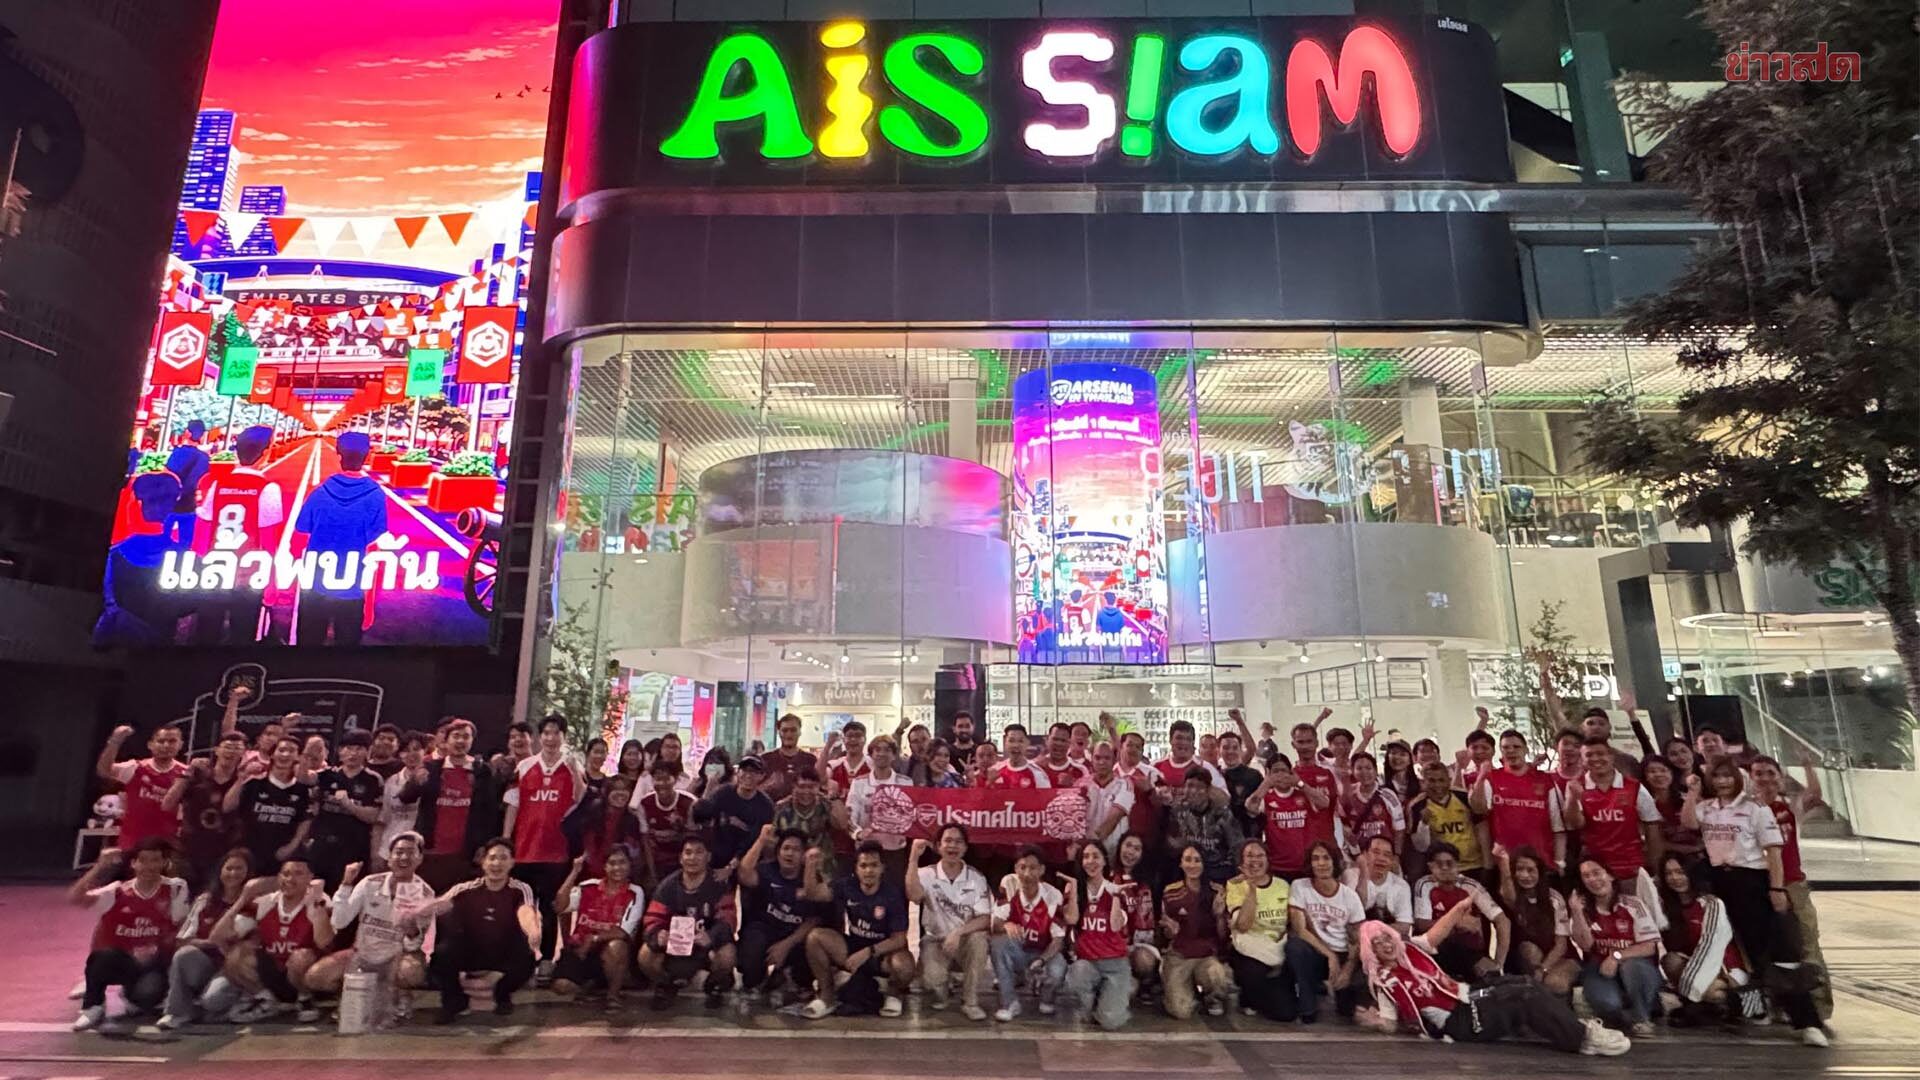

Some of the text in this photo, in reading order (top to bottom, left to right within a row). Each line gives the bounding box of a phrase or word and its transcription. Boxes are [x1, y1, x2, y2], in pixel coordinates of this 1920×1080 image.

[238, 292, 345, 305] EMIRATES
[1071, 380, 1132, 393] ARSENAL
[217, 504, 246, 540] 8
[159, 531, 440, 590] แล้วพบกัน
[825, 688, 876, 700] HUAWEI
[530, 789, 560, 802] JVC
[1493, 794, 1546, 809] Dreamcast
[1592, 809, 1625, 822] JVC
[1437, 821, 1464, 834] JVC
[1082, 917, 1107, 932] JVC
[1023, 928, 1038, 942] VC
